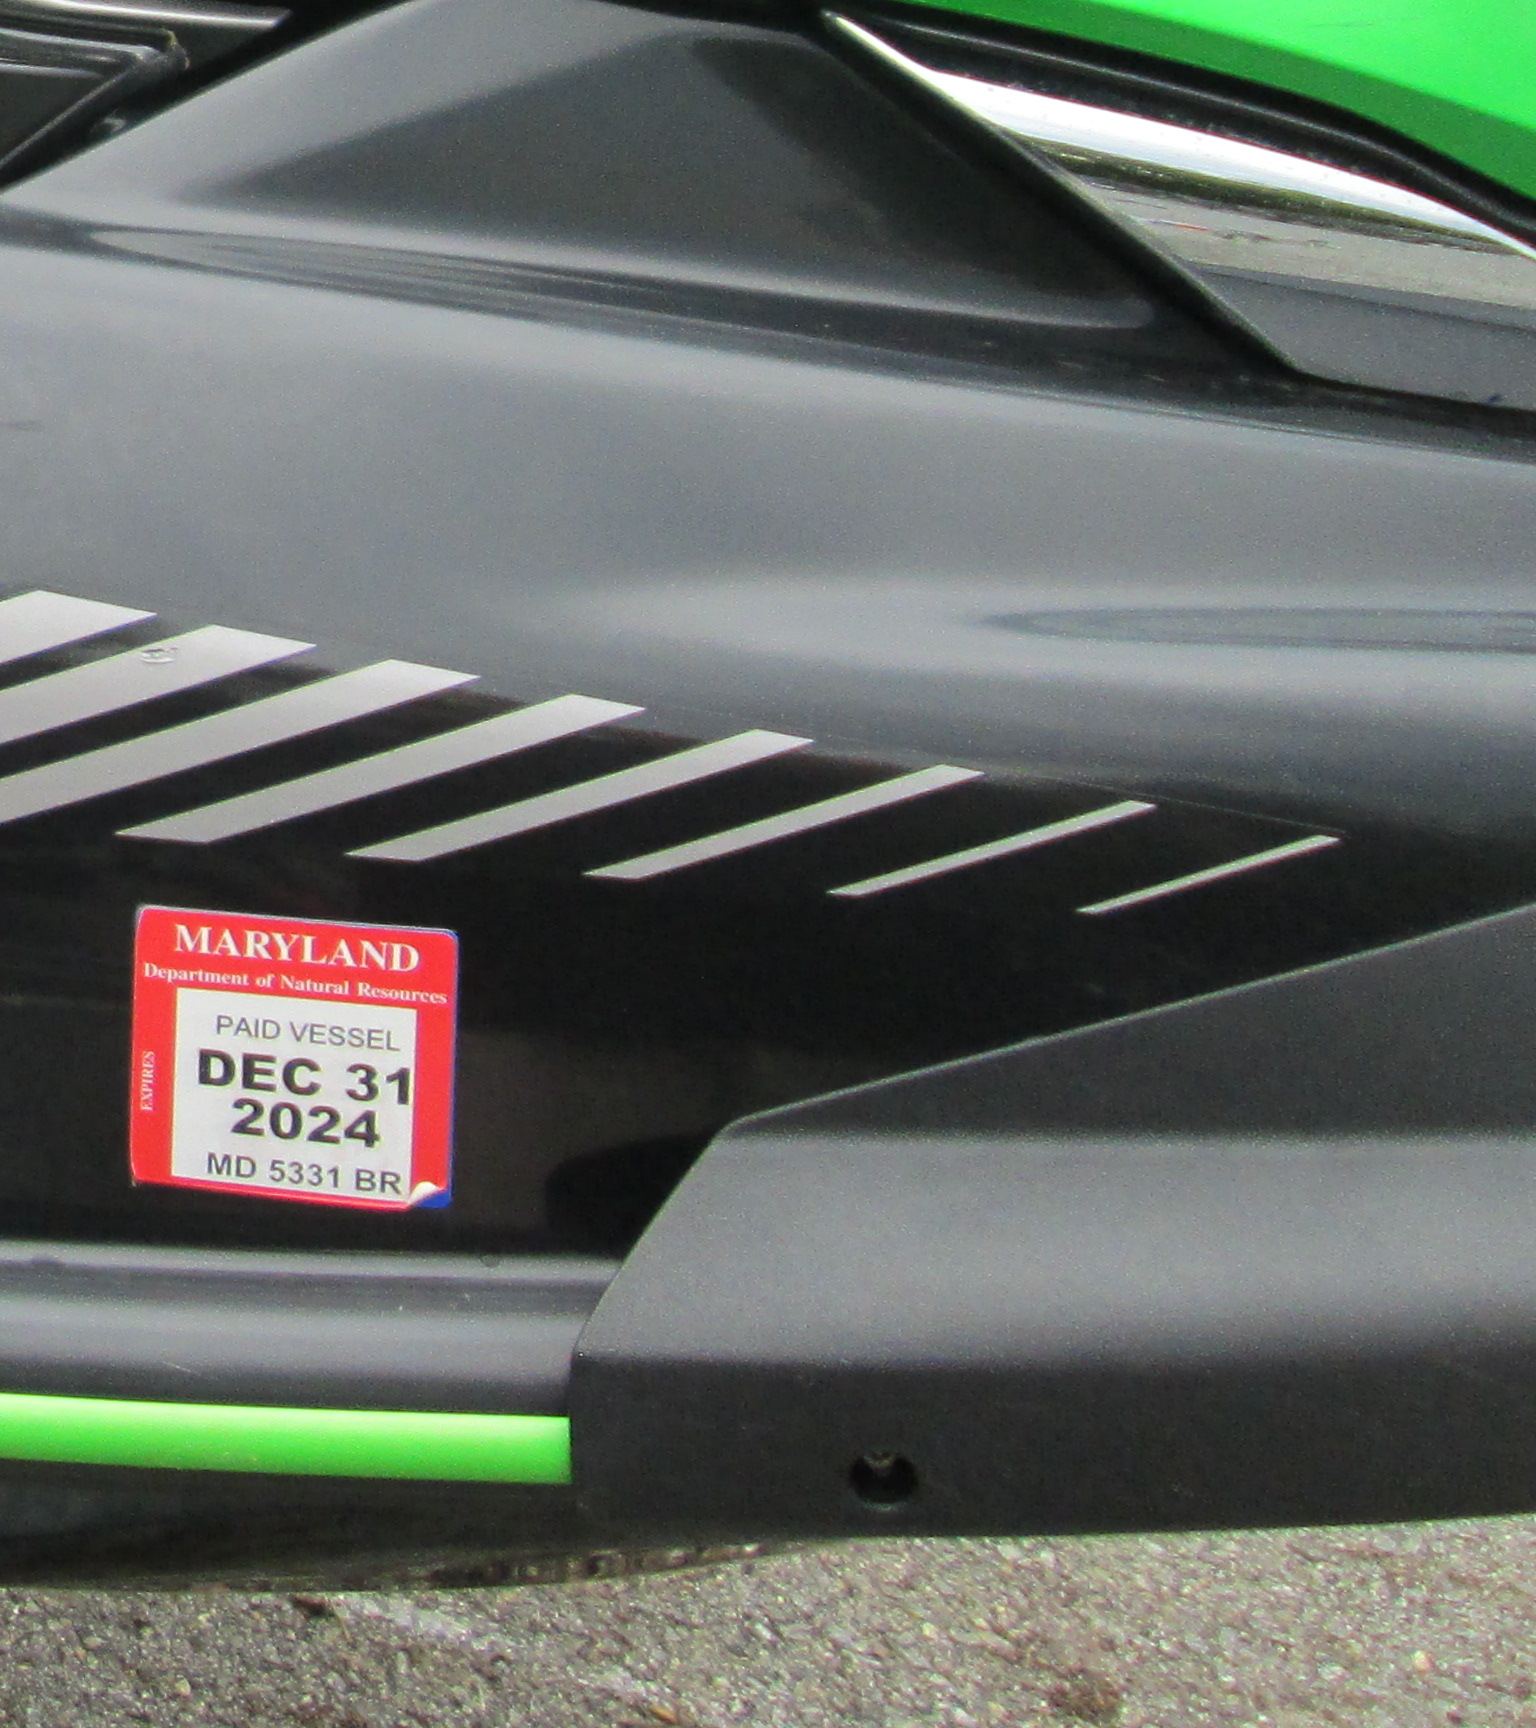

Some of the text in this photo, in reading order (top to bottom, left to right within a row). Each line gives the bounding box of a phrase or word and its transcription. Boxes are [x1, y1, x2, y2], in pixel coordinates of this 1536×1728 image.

[174, 923, 420, 972] MARYLAND
[144, 962, 447, 1004] Department of Natural Resources
[216, 1015, 401, 1051] PAID VESSEL
[140, 1050, 156, 1112] EXPIRES
[198, 1048, 412, 1106] DEC 31
[231, 1098, 381, 1148] 2024
[207, 1152, 402, 1195] MD 5331 BR
